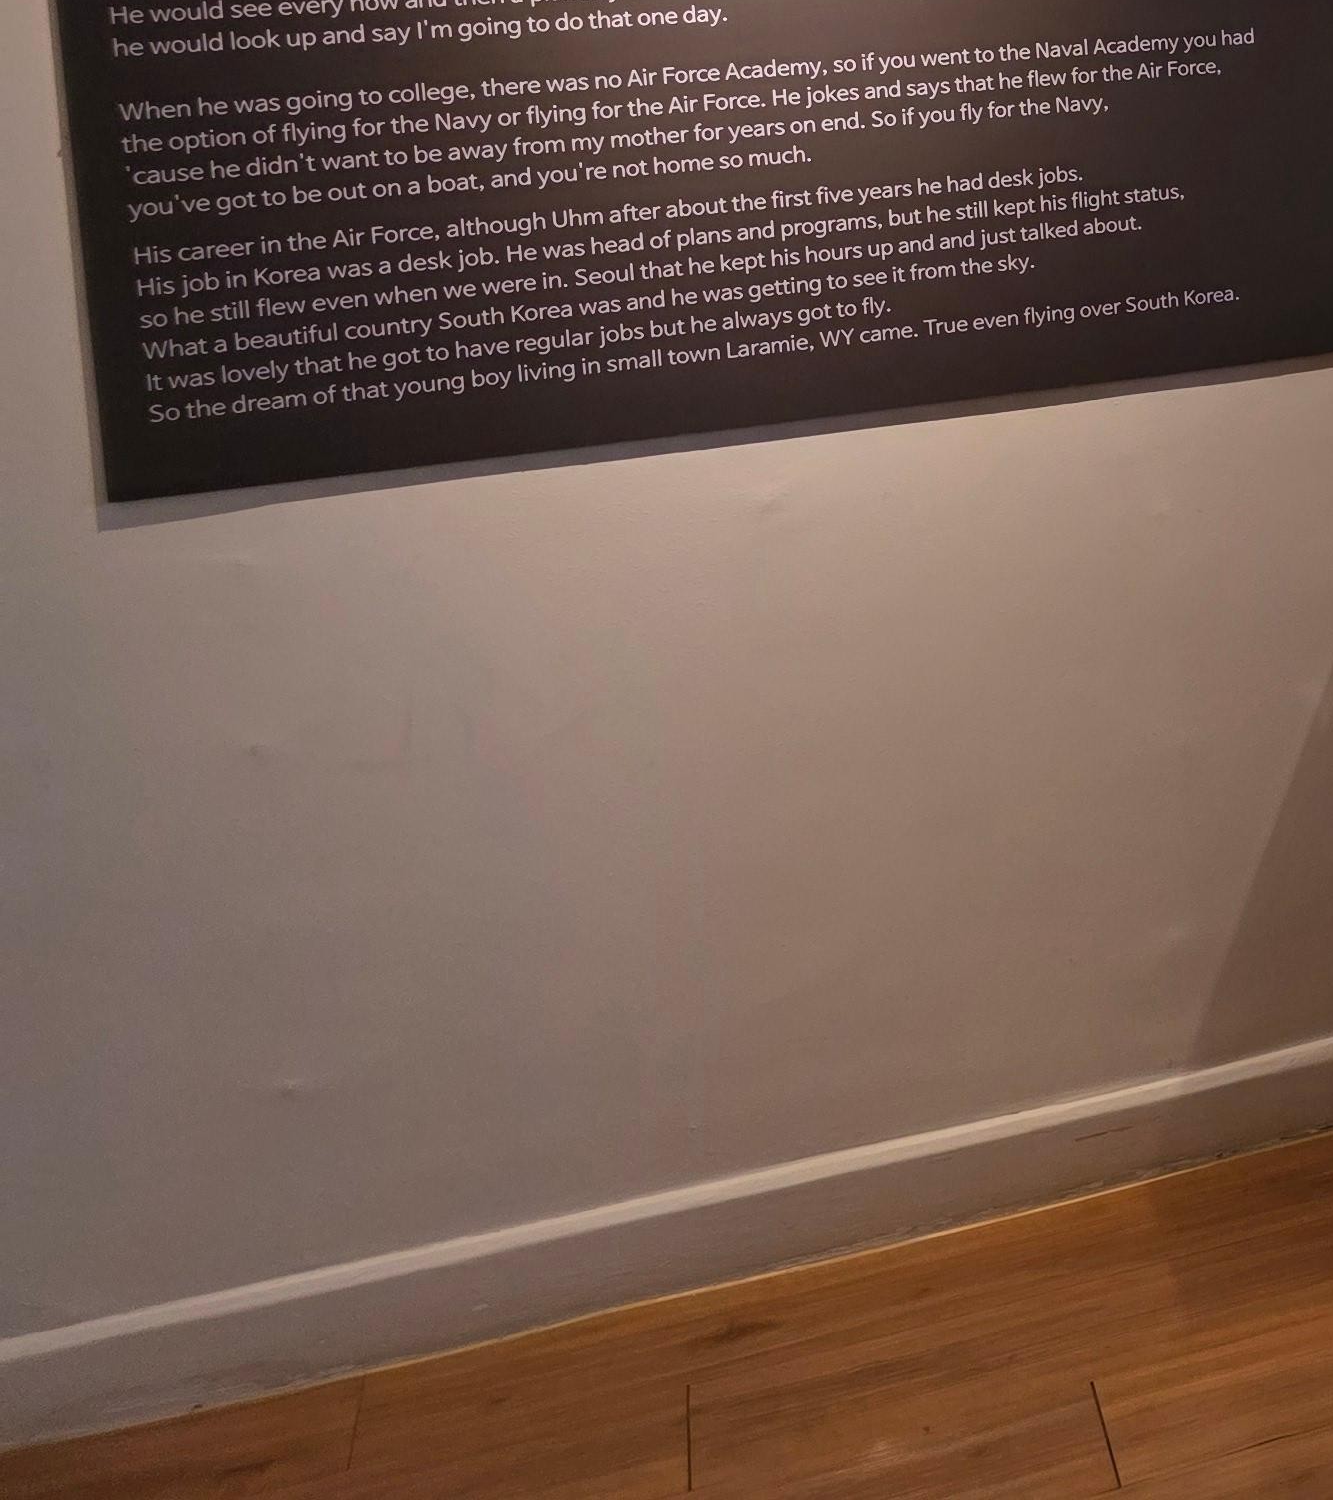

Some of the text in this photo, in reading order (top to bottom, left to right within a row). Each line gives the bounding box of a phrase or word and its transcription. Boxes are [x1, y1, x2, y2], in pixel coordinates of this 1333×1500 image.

[149, 289, 1240, 423] So the dream of that young boy living in small town Laramie, WY came. True even flying over South Korea.
